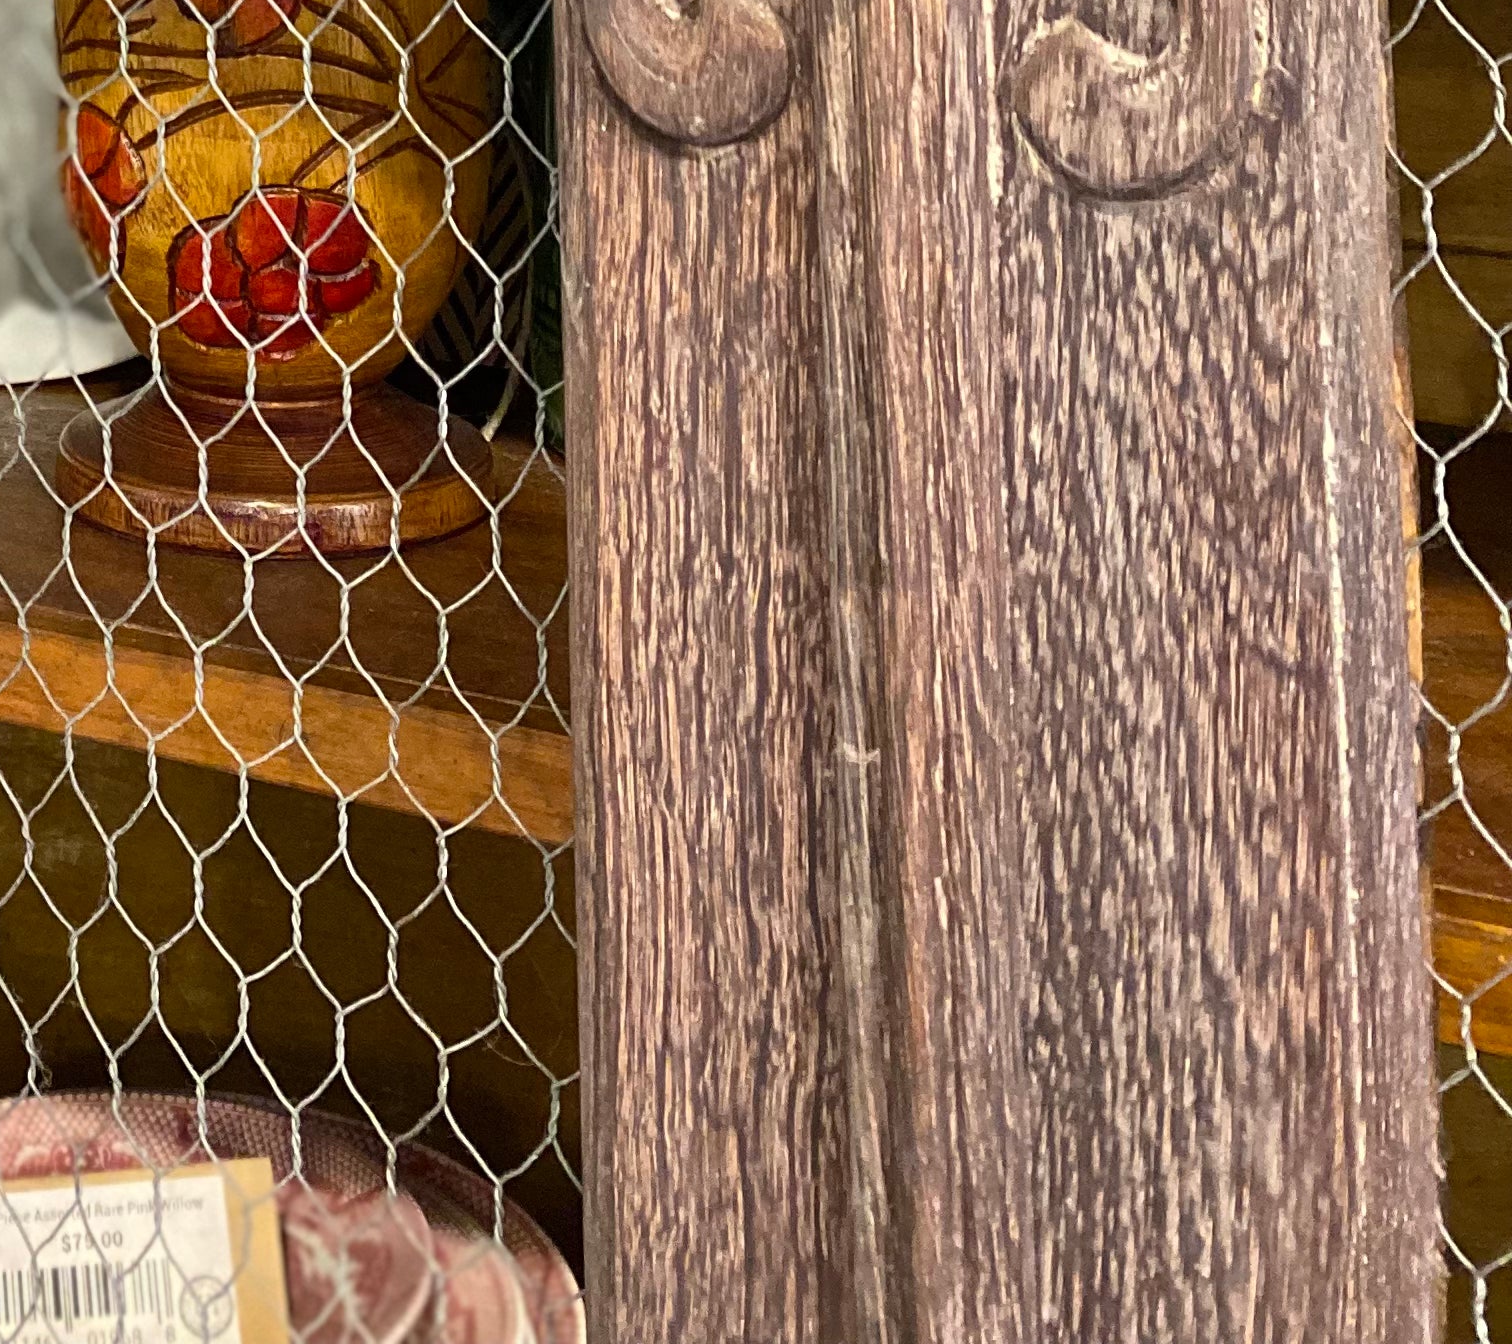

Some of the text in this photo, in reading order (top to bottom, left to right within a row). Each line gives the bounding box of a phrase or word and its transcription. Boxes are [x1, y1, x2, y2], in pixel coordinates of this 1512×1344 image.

[34, 1202, 91, 1222] Assoted
[94, 1201, 123, 1217] Rare
[127, 1198, 156, 1215] Pink
[61, 1230, 123, 1254] $7900
